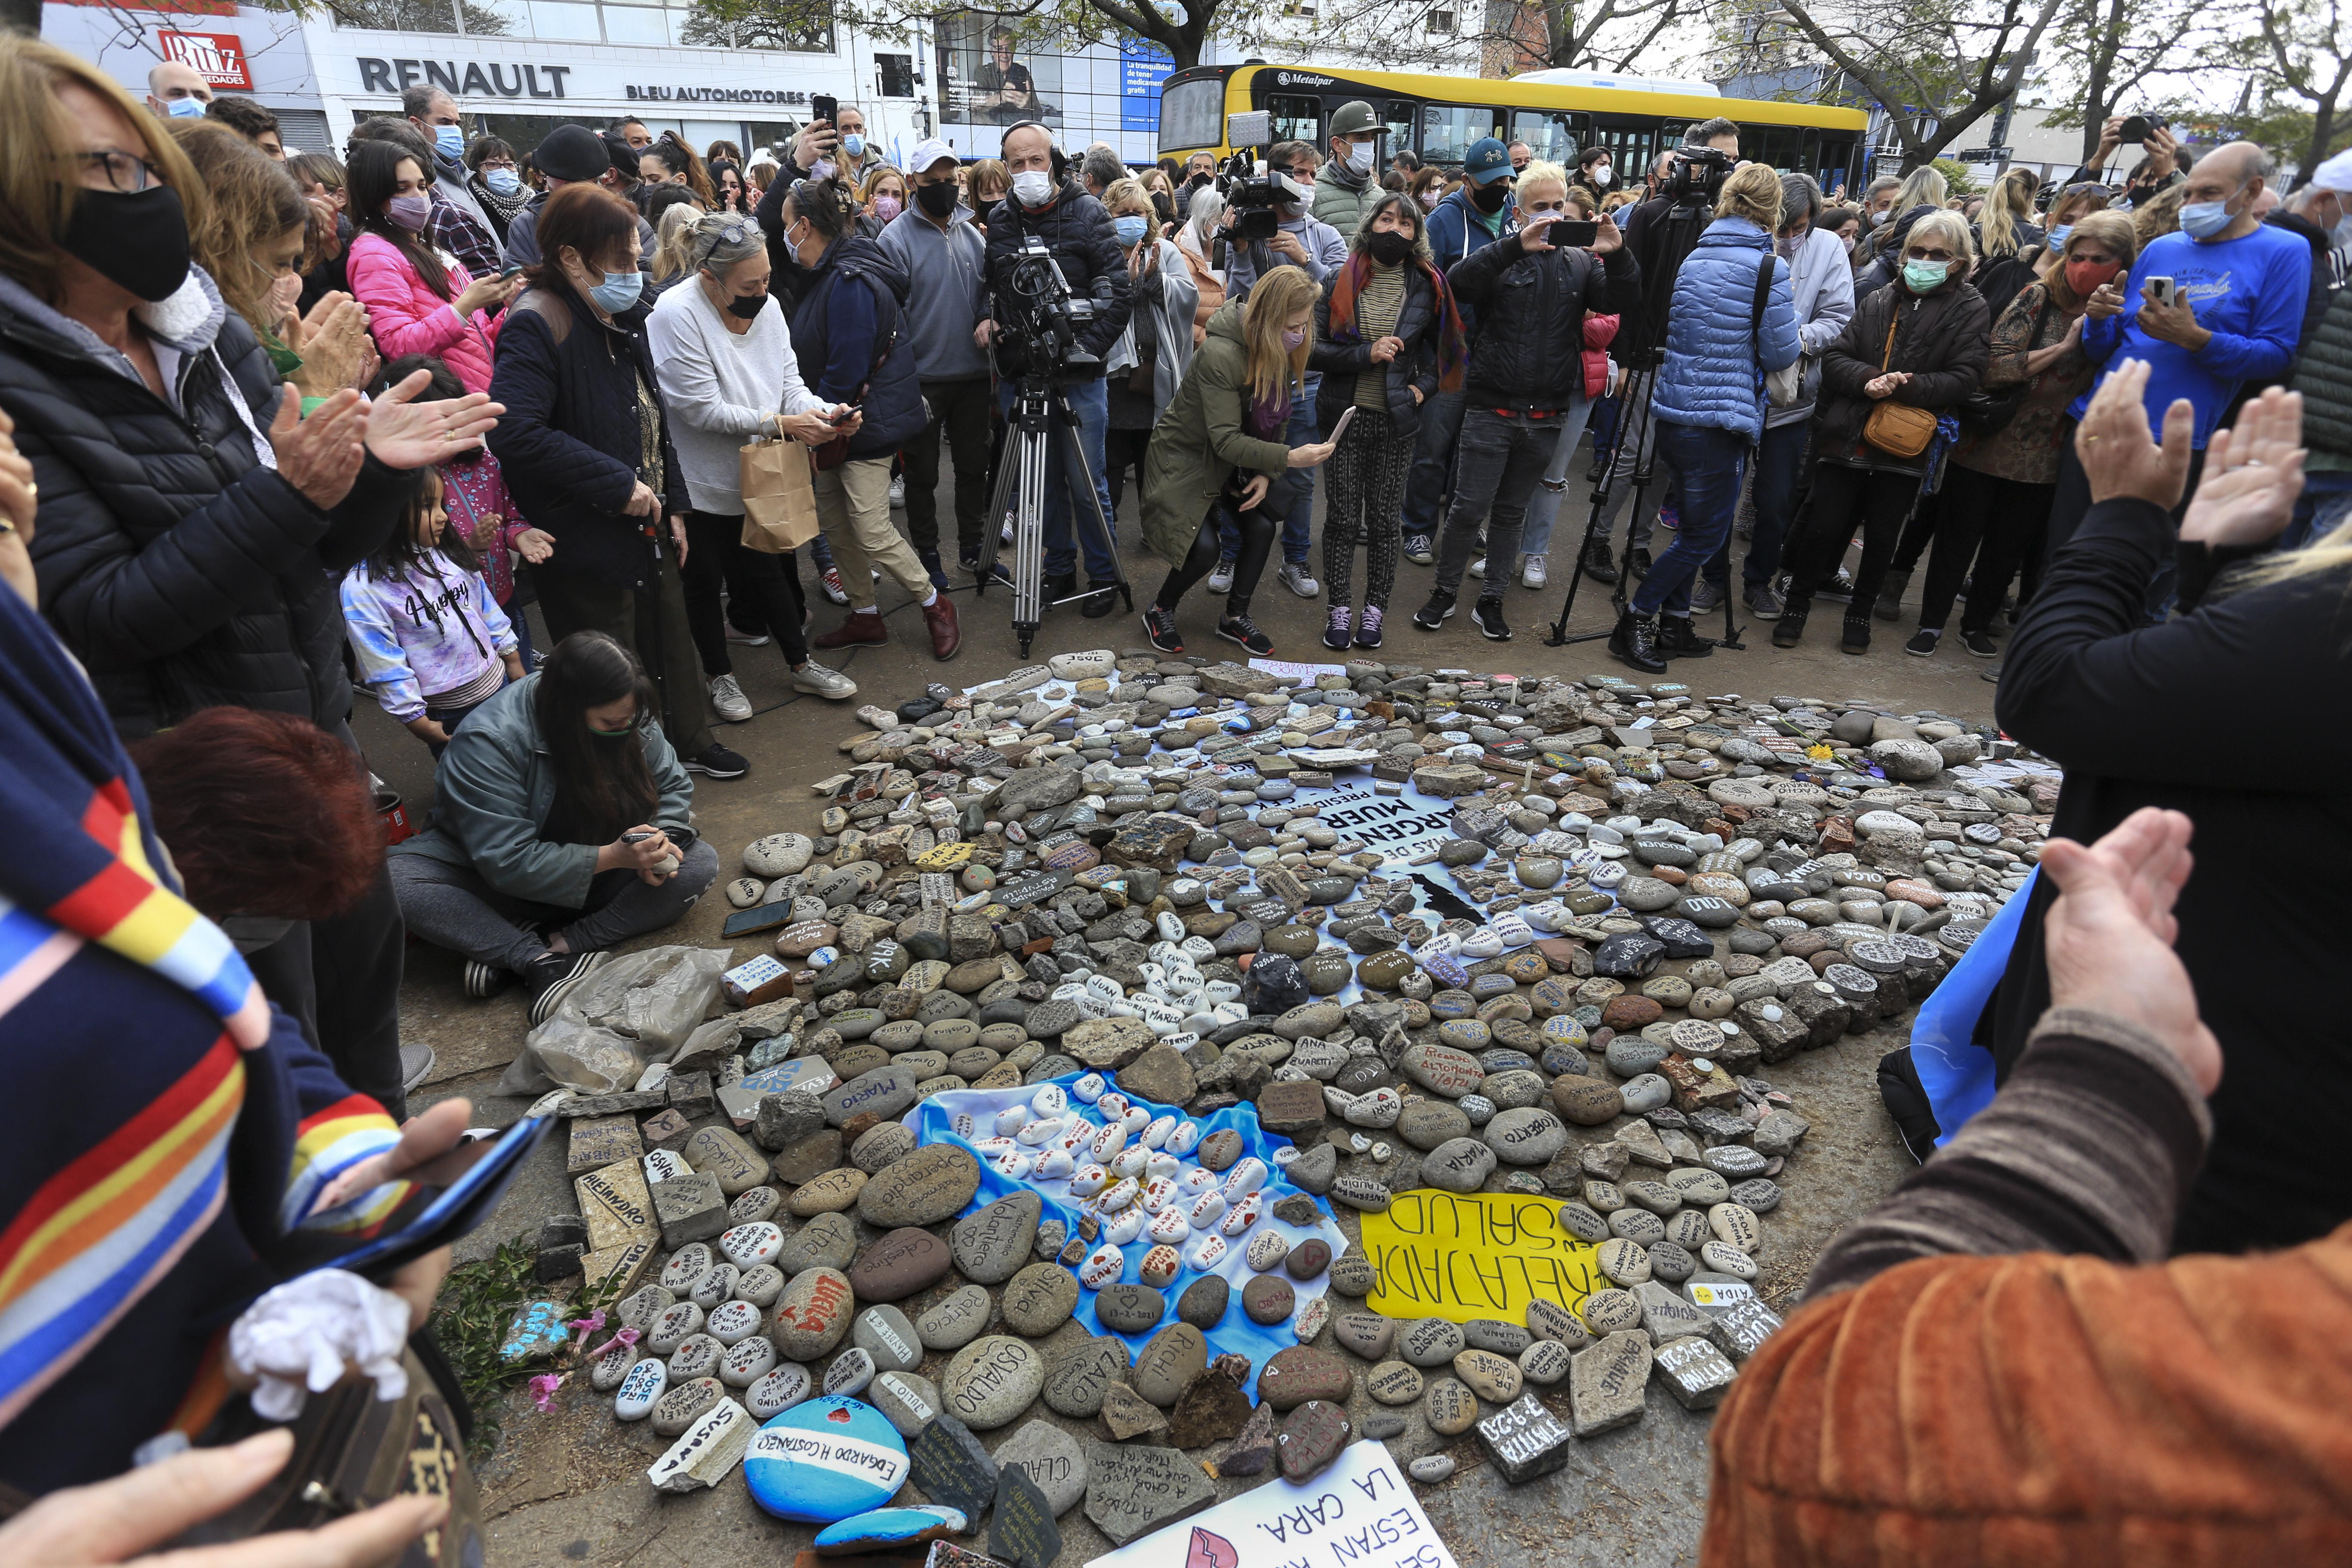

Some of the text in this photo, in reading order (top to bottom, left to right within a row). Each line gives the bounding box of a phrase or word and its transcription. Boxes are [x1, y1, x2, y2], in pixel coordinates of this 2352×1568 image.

[1136, 63, 1172, 71] tranquilidad
[202, 75, 245, 85] IEDADES
[356, 57, 570, 98] RENAULT
[1291, 74, 1334, 86] Metalpar
[626, 85, 671, 99] BLEU
[677, 87, 805, 104] AUTOMOTORES
[405, 581, 469, 627] Happy
[1004, 667, 1045, 684] ARMANDO
[974, 719, 988, 729] LUIS
[1009, 770, 1061, 796] EDUARDO
[1008, 824, 1024, 840] SOLANGE
[1383, 845, 1407, 861] DE
[1638, 841, 1692, 853] NEUQUEN
[1313, 879, 1343, 889] David
[1699, 876, 1744, 891] NORA
[1842, 871, 1882, 882] OLGA
[738, 878, 755, 900] WALTER
[1010, 884, 1055, 903] FACUNDO
[1686, 898, 1732, 912] LOLO
[1166, 913, 1180, 936] NORA
[1220, 922, 1254, 942] EVA
[1285, 930, 1309, 940] ANA
[1091, 977, 1117, 997] JUAN
[1178, 976, 1201, 986] PINO
[1081, 1001, 1106, 1017] TERE
[1134, 995, 1158, 1004] CUCA
[1149, 1010, 1182, 1025] MARISA
[1237, 1036, 1285, 1050] MARTA
[1301, 1037, 1326, 1050] ANA
[900, 1056, 936, 1068] Osvaldo
[842, 1079, 896, 1109] MARIO
[918, 1081, 957, 1095] Marisa
[1505, 1114, 1559, 1143] ROBERTO
[1093, 1124, 1117, 1154] COCO
[696, 1134, 750, 1180] RICARDO
[1445, 1143, 1490, 1172] MARIA
[882, 1155, 968, 1204] Sperandio
[1341, 1178, 1387, 1193] CLAUDIA
[1672, 1172, 1724, 1192] LEGARRETA DR.
[661, 1193, 702, 1204] TODOS
[909, 1176, 962, 1209] Matrimonio
[665, 1205, 687, 1215] POR
[1192, 1191, 1219, 1218] ZULEMA
[1388, 1194, 1595, 1253] SALUD EN
[1627, 1217, 1660, 1236] HECTOR
[730, 1226, 760, 1255] 05-08-20
[740, 1227, 772, 1259] LEONOR
[1002, 1211, 1028, 1257] Matrimonio
[693, 1248, 703, 1266] OTTO
[1014, 1268, 1064, 1314] Silvia
[1257, 1292, 1291, 1310] MAURO
[925, 1290, 985, 1333] Patricia
[1584, 1289, 1627, 1320] THOMPSON
[1600, 1301, 1637, 1328] HOSPITAL
[719, 1317, 750, 1333] HECTOR
[1109, 1311, 1155, 1319] 13-2-2021
[1349, 1323, 1380, 1331] DIANA
[747, 1337, 770, 1360] MOLINA
[1412, 1322, 1454, 1357] ERNESTO
[1441, 1334, 1460, 1348] DR.
[955, 1344, 1027, 1413] OSVALDO
[1072, 1350, 1118, 1403] LALO
[1370, 1366, 1410, 1391] NORBERTO
[1471, 1359, 1515, 1382] MIGUEL
[637, 1373, 662, 1402] JOSE
[757, 1375, 805, 1406] ARGENTINO
[1387, 1375, 1417, 1394] PANNO
[1446, 1382, 1458, 1420] PEREZ
[757, 1436, 819, 1455] COSTANZO
[836, 1448, 897, 1481] EDGARDO
[1257, 1467, 1395, 1543] CARA. LA
[1330, 1507, 1419, 1567] ESTAN
